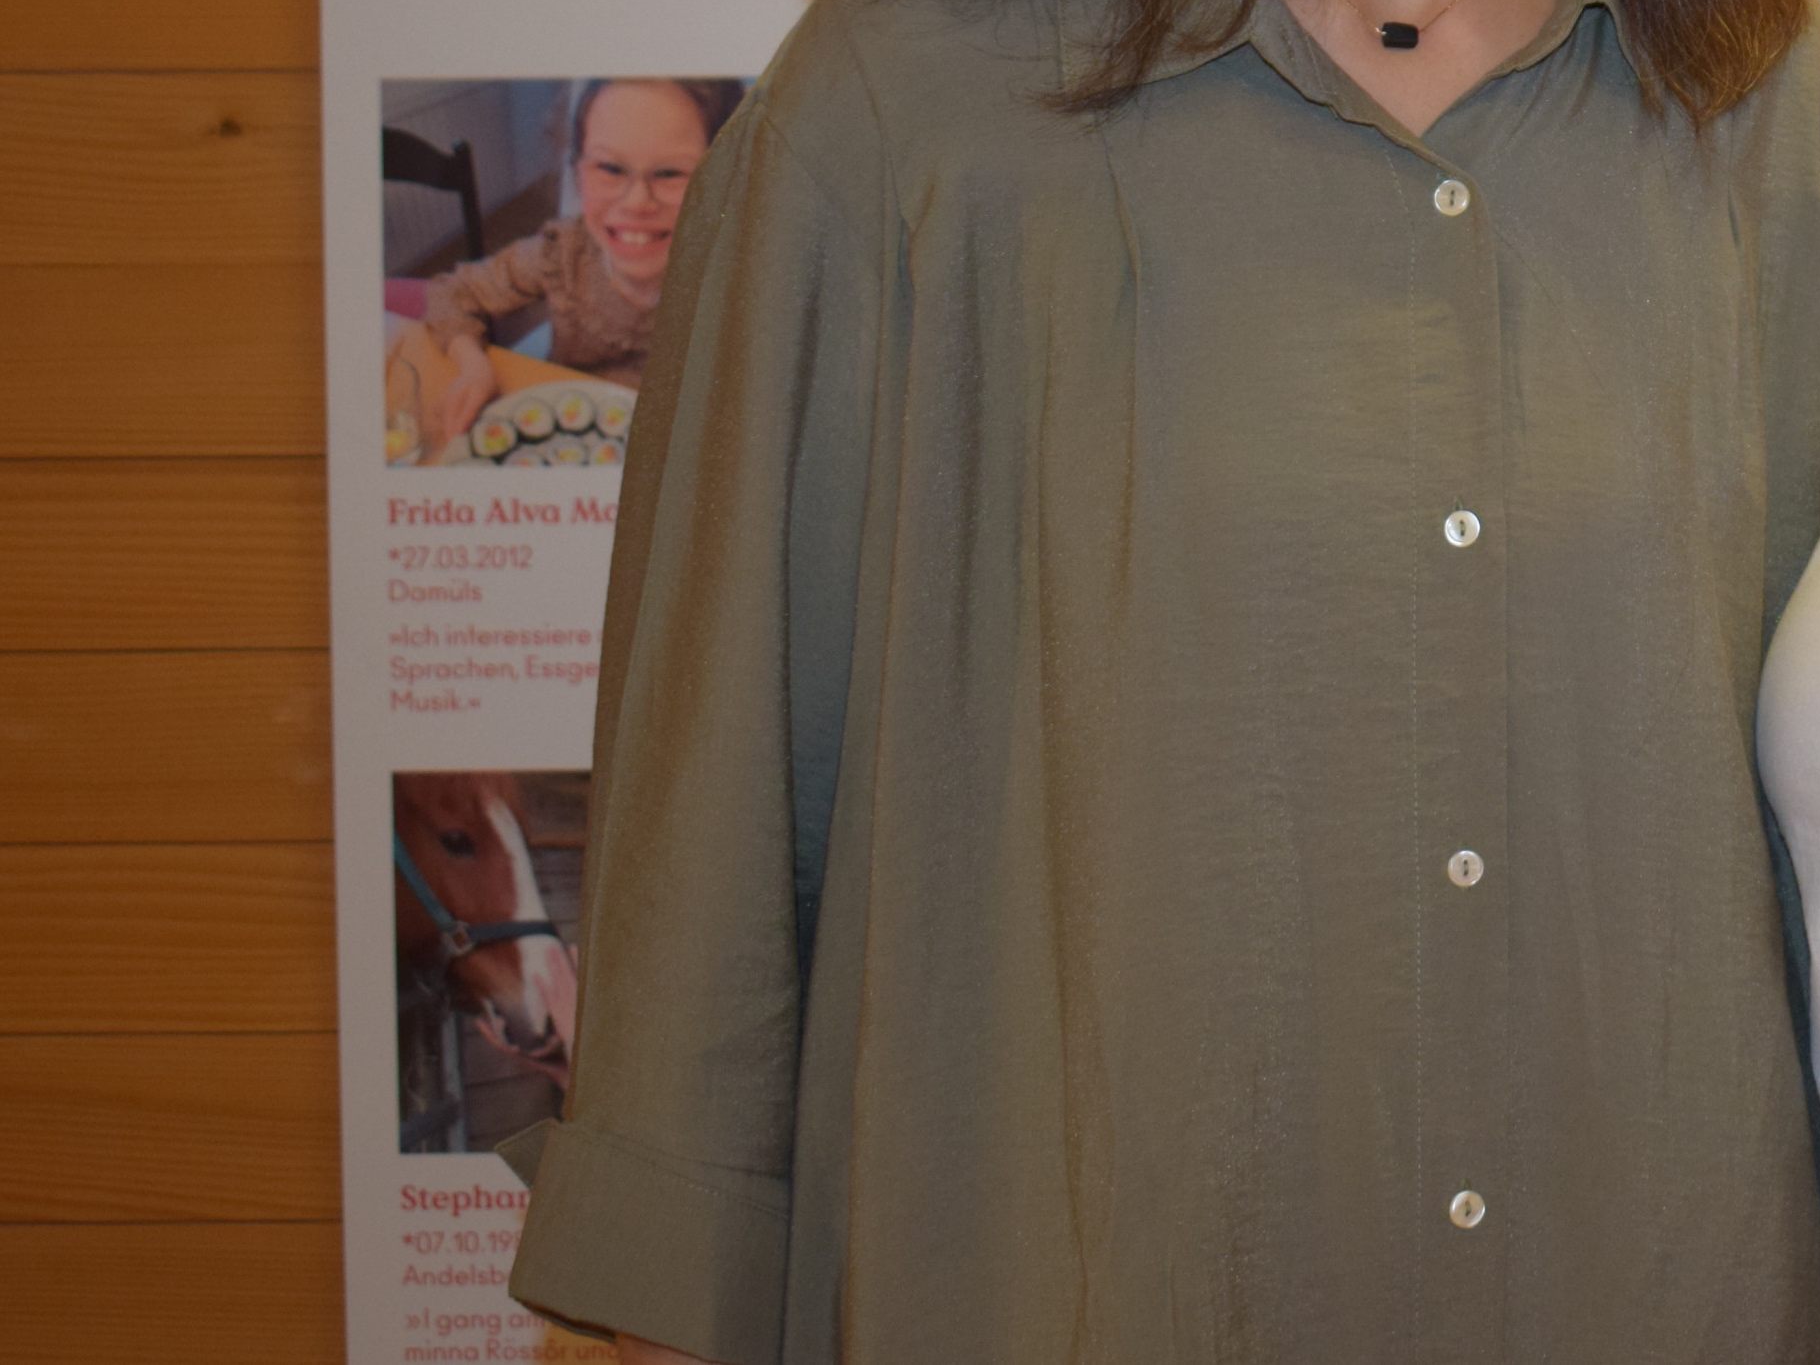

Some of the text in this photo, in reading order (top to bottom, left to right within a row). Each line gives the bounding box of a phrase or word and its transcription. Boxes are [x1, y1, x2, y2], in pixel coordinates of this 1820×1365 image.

[387, 497, 476, 525] Frida
[484, 497, 561, 525] Alva
[447, 623, 592, 647] interessiere
[389, 656, 518, 685] Sprachen,
[436, 1312, 502, 1335] gang
